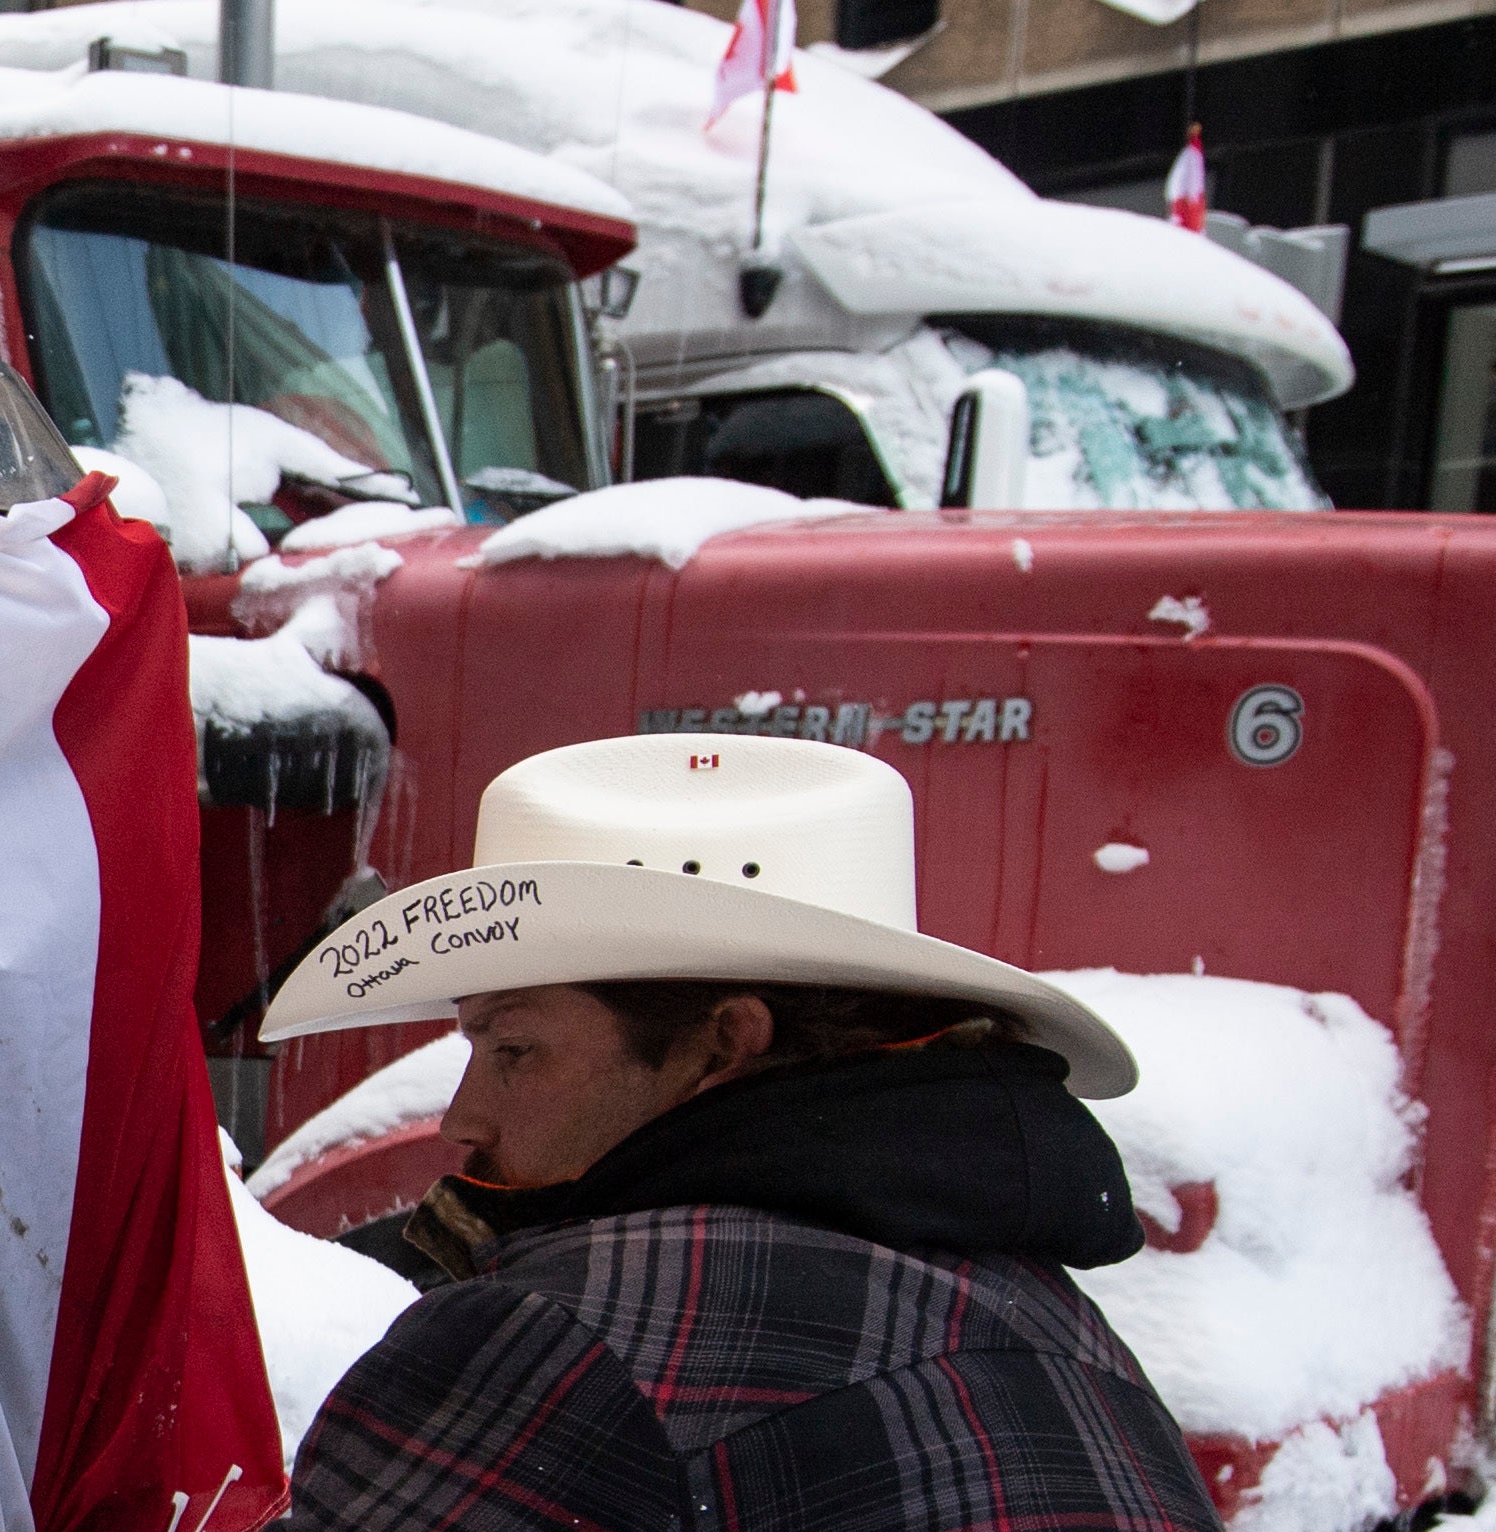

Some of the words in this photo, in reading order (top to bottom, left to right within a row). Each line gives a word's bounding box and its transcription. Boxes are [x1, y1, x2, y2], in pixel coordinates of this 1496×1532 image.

[1227, 684, 1305, 767] 6
[319, 919, 399, 978] 2022
[402, 879, 543, 935] FREEDOM
[346, 956, 420, 999] Ottawa
